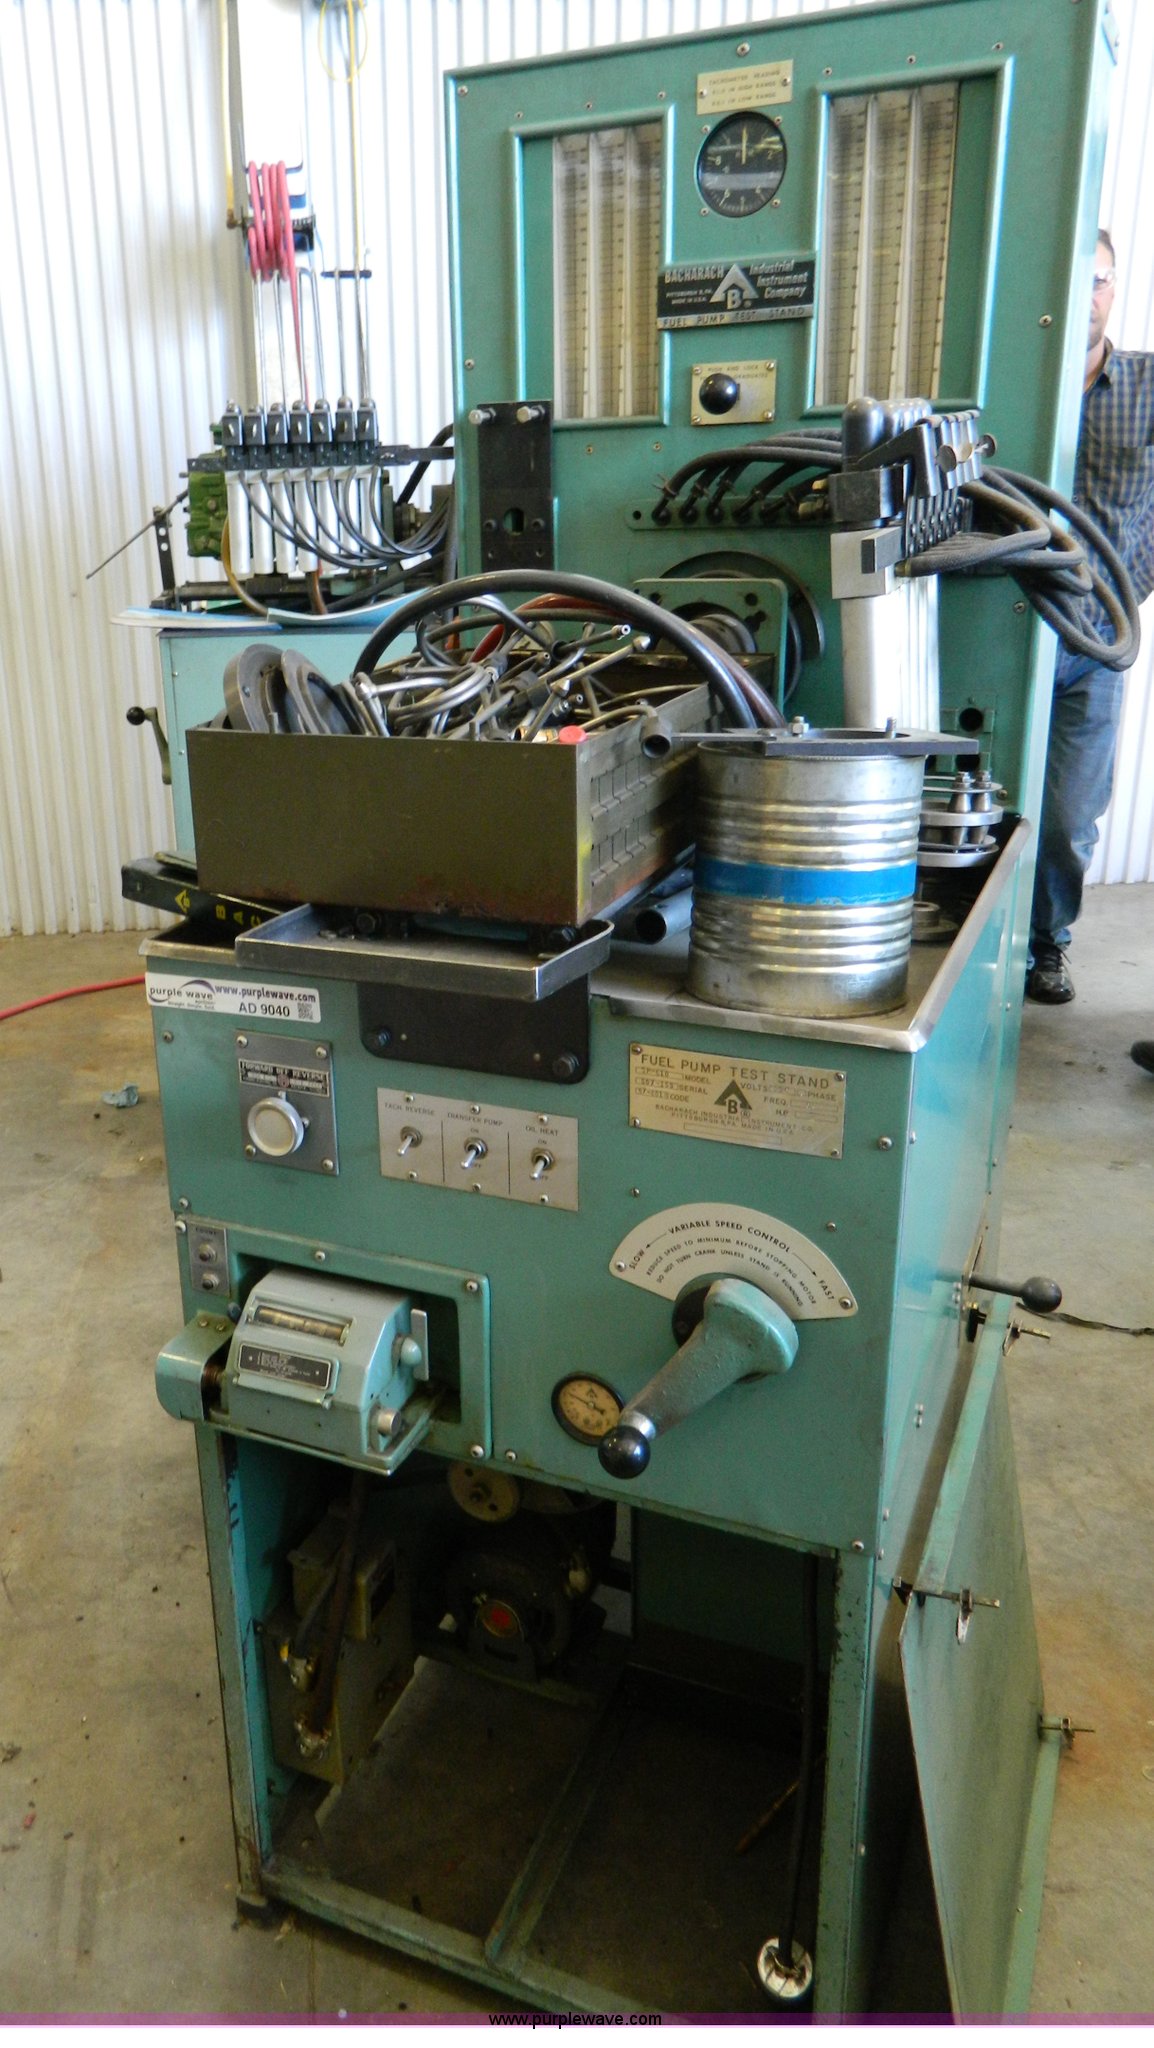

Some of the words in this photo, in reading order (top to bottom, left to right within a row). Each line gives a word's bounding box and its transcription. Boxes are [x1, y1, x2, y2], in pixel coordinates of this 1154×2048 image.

[665, 265, 724, 284] BACHARACH
[750, 260, 795, 275] Industrial
[757, 272, 808, 287] Instrument
[764, 286, 806, 299] Company
[663, 317, 687, 328] FUEL
[697, 314, 725, 325] PUMP
[735, 311, 757, 321] TEST
[769, 307, 805, 318] STAND
[150, 986, 182, 999] purple
[186, 990, 213, 1000] wave
[215, 984, 317, 1003] www.purplewave.com
[239, 1002, 257, 1014] AD
[260, 1004, 291, 1018] 9040
[641, 1054, 675, 1069] FUEL
[681, 1059, 721, 1075] PUMP
[730, 1066, 769, 1082] TEST
[778, 1072, 829, 1089] STAND
[685, 1074, 711, 1085] MODEL
[679, 1084, 708, 1095] SERIAL
[741, 1083, 768, 1093] VOLTS
[807, 1091, 837, 1102] PHASE
[669, 1093, 690, 1103] CODE
[405, 1106, 435, 1117] REVERSE
[728, 1099, 738, 1114] B
[447, 1111, 482, 1124] TRANSFER
[483, 1118, 503, 1127] PUMP
[539, 1128, 559, 1137] HEAT
[669, 1220, 711, 1234] VARIABLE
[715, 1220, 743, 1231] SPEED
[747, 1226, 790, 1253] CONTROL
[629, 1248, 645, 1270] SLOW
[818, 1280, 835, 1300] FAST
[664, 1244, 681, 1256] SPEED
[735, 1240, 762, 1253] BEFORE
[766, 1252, 797, 1279] STOPPING
[799, 1281, 817, 1304] MOTOR
[720, 1249, 744, 1259] UNLESS
[749, 1257, 770, 1271] STAND
[782, 1279, 803, 1307] RUNNING
